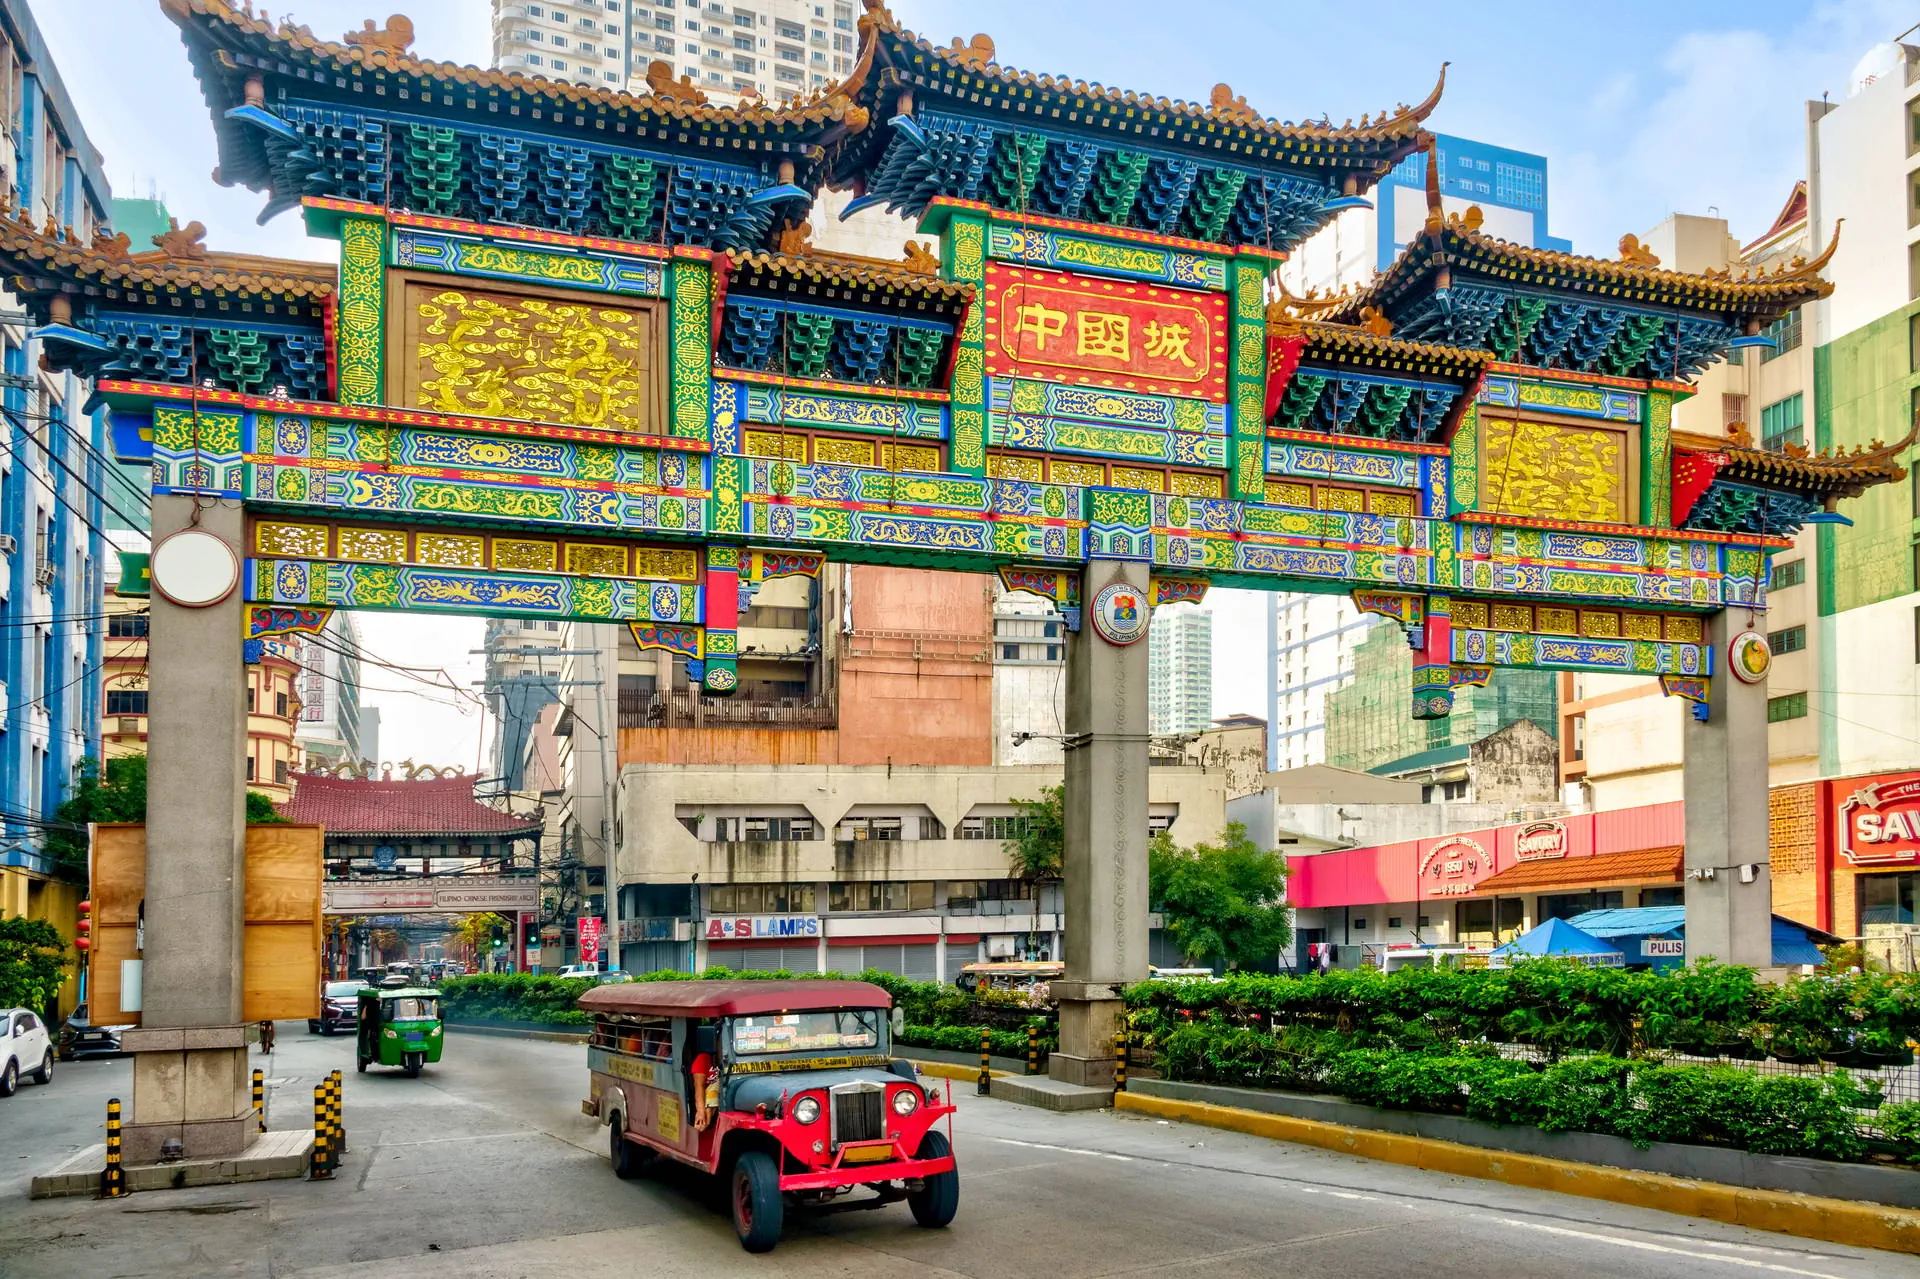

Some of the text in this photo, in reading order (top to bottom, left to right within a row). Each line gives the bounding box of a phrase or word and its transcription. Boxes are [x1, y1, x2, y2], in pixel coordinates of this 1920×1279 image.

[1013, 302, 1197, 368] 中國城
[1108, 631, 1139, 640] PILIPINAS
[1898, 782, 1920, 794] THE
[1518, 833, 1562, 853] SAVORY
[706, 918, 817, 937] A&S LAMPS
[1650, 943, 1682, 953] PULIS
[851, 1054, 889, 1066] DIVISORIA
